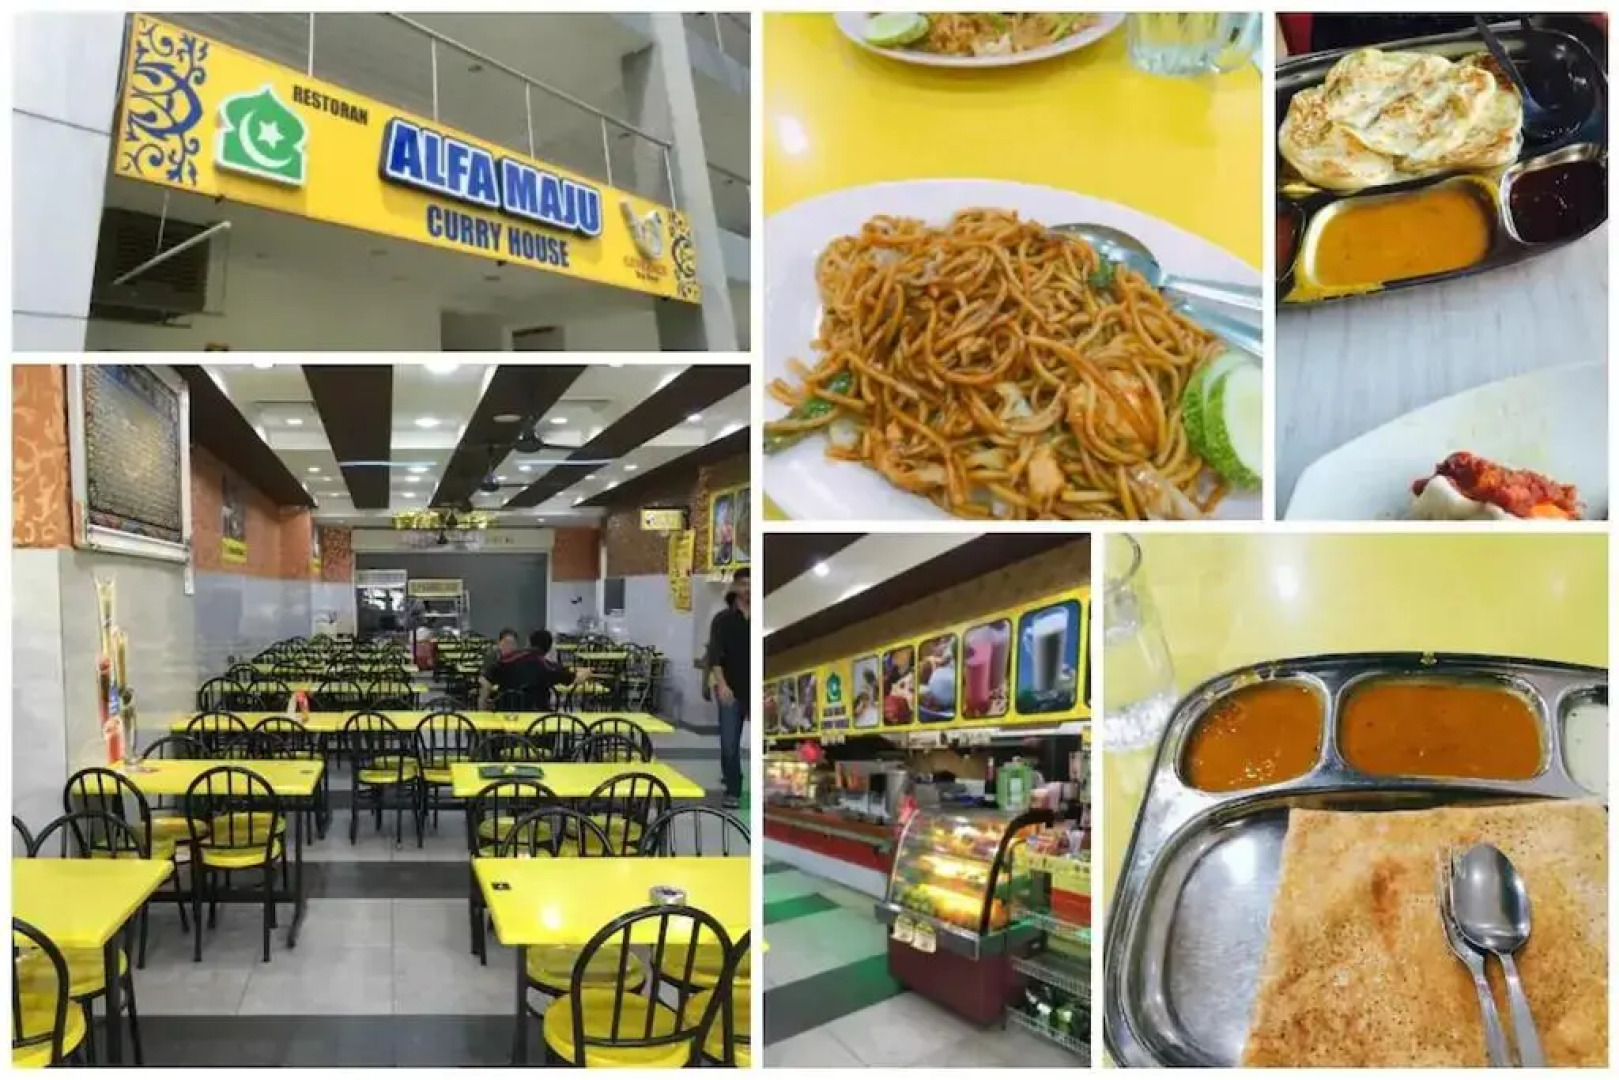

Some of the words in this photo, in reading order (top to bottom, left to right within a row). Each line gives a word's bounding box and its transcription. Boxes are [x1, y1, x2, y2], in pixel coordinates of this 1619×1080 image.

[293, 85, 368, 125] RESTORAN
[386, 119, 499, 207] ALFA
[502, 158, 602, 236] MAJU
[427, 204, 502, 253] CURRY
[508, 226, 570, 267] HOUSE
